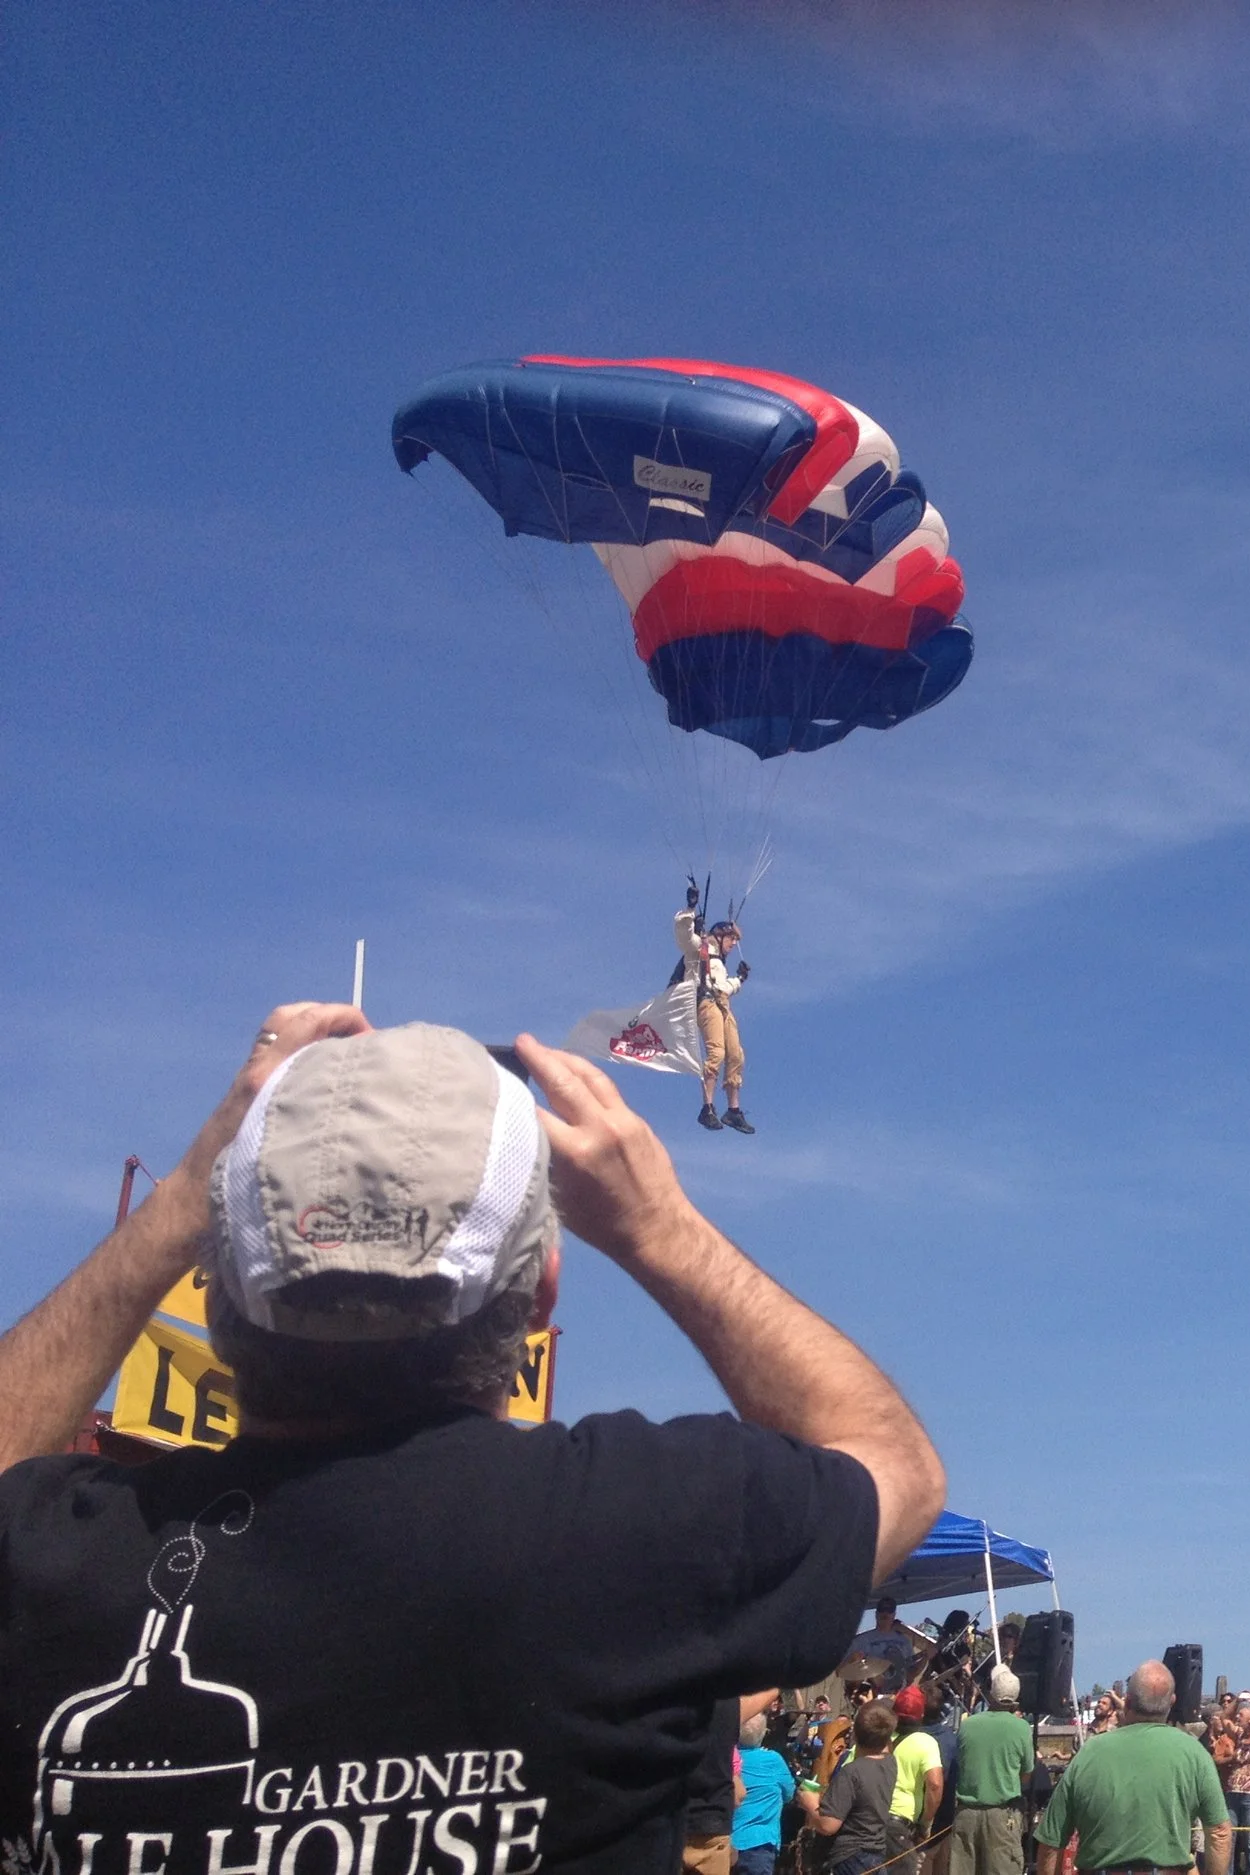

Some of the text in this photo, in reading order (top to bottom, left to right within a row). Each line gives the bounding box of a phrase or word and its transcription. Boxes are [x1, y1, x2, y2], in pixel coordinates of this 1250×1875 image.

[638, 465, 705, 492] Classic
[254, 1748, 527, 1814] GARDNER
[206, 1797, 548, 1875] HOUSE
